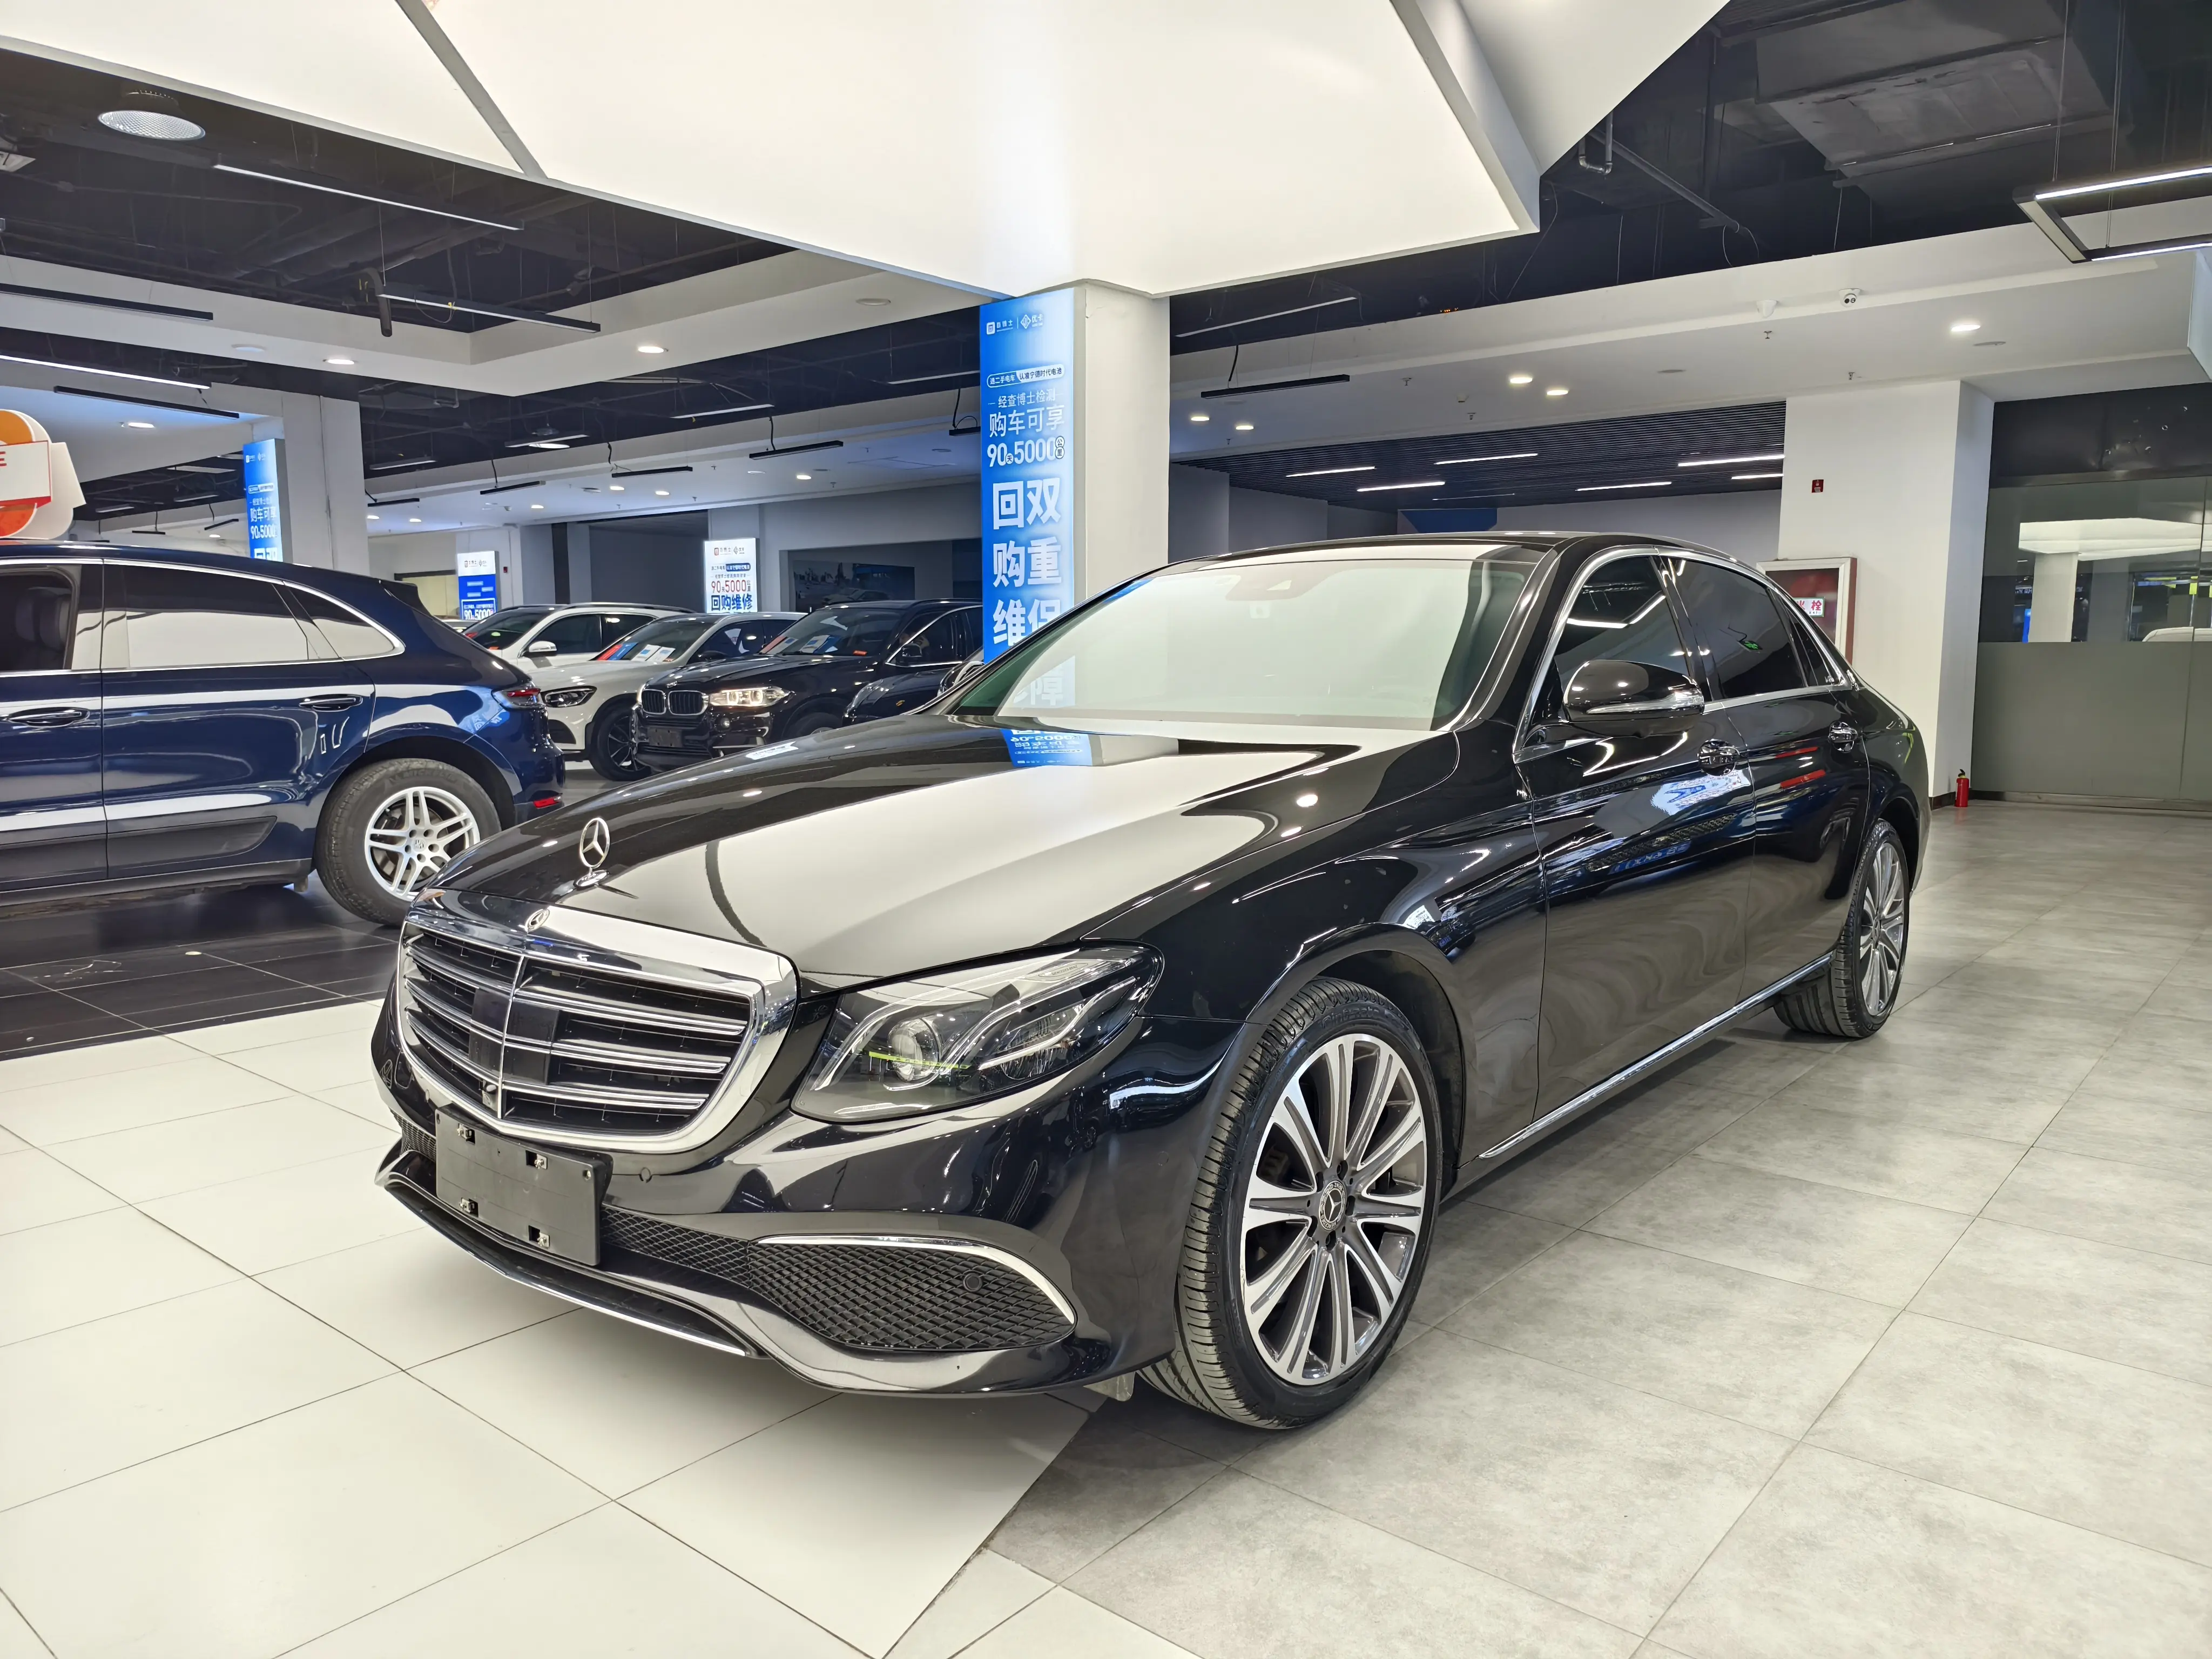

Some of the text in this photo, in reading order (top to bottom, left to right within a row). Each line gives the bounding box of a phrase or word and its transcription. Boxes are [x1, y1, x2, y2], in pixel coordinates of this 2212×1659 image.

[998, 388, 1056, 408] 经查博士检测
[989, 404, 1065, 437] 购车可享
[711, 594, 753, 611] 回购维修
[1051, 965, 1078, 976] MERCEDES-BENZ
